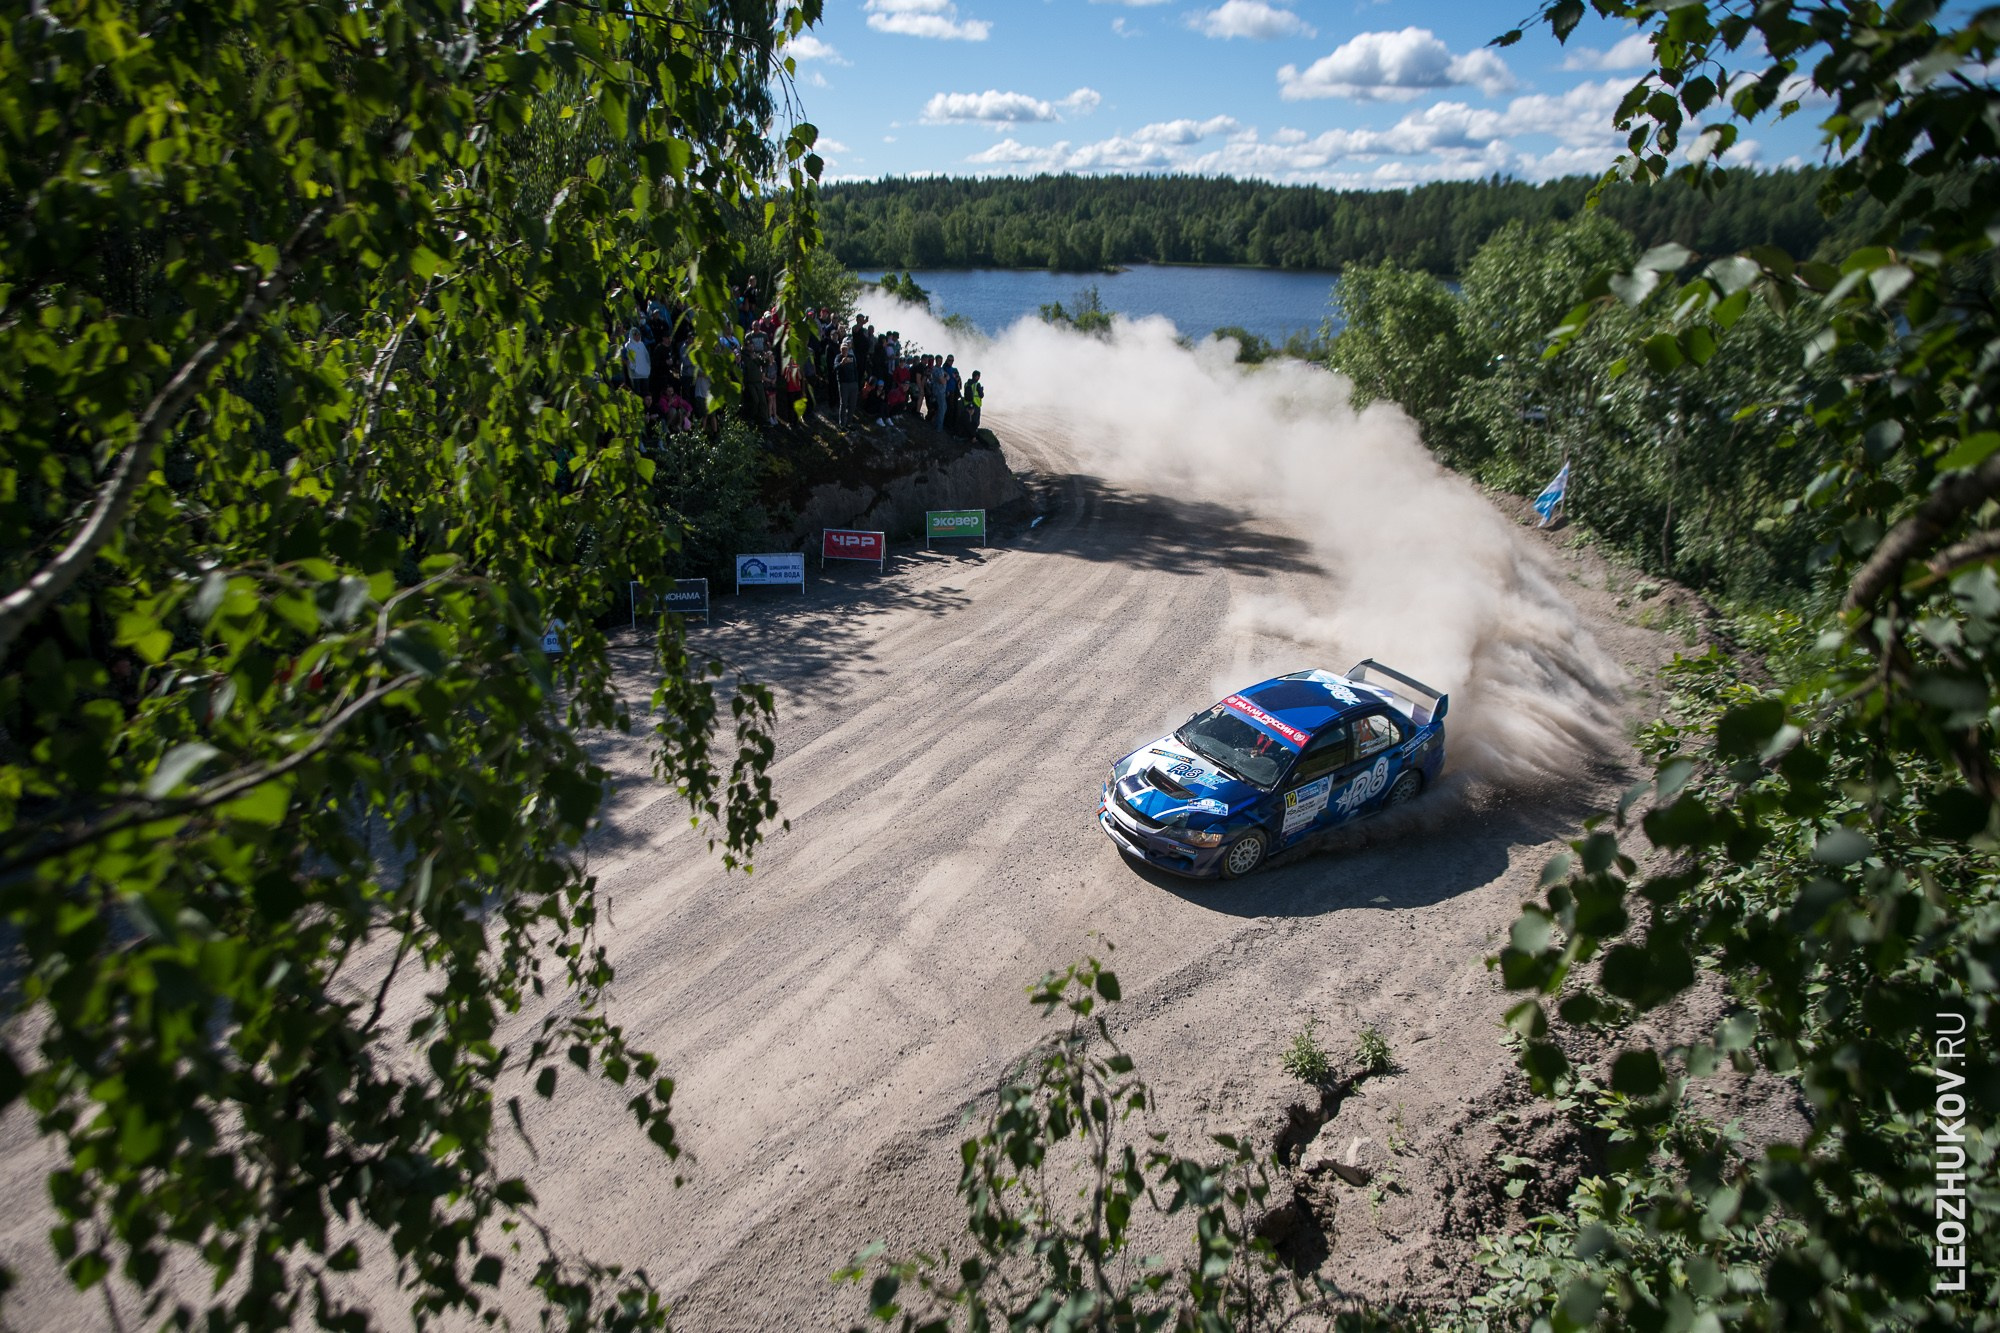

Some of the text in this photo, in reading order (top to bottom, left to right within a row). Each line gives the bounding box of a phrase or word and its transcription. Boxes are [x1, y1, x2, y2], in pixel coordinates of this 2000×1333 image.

[932, 516, 979, 528] эковер
[831, 535, 875, 547] ЧРР
[783, 571, 801, 579] ВОДА
[654, 592, 701, 601] YKOHAMA
[1211, 703, 1226, 714] 12
[1235, 700, 1263, 717] РАЛЛИ
[1261, 712, 1295, 736] РОССИИ
[1167, 762, 1205, 779] R8
[1346, 756, 1389, 811] R8
[1286, 792, 1297, 807] 12
